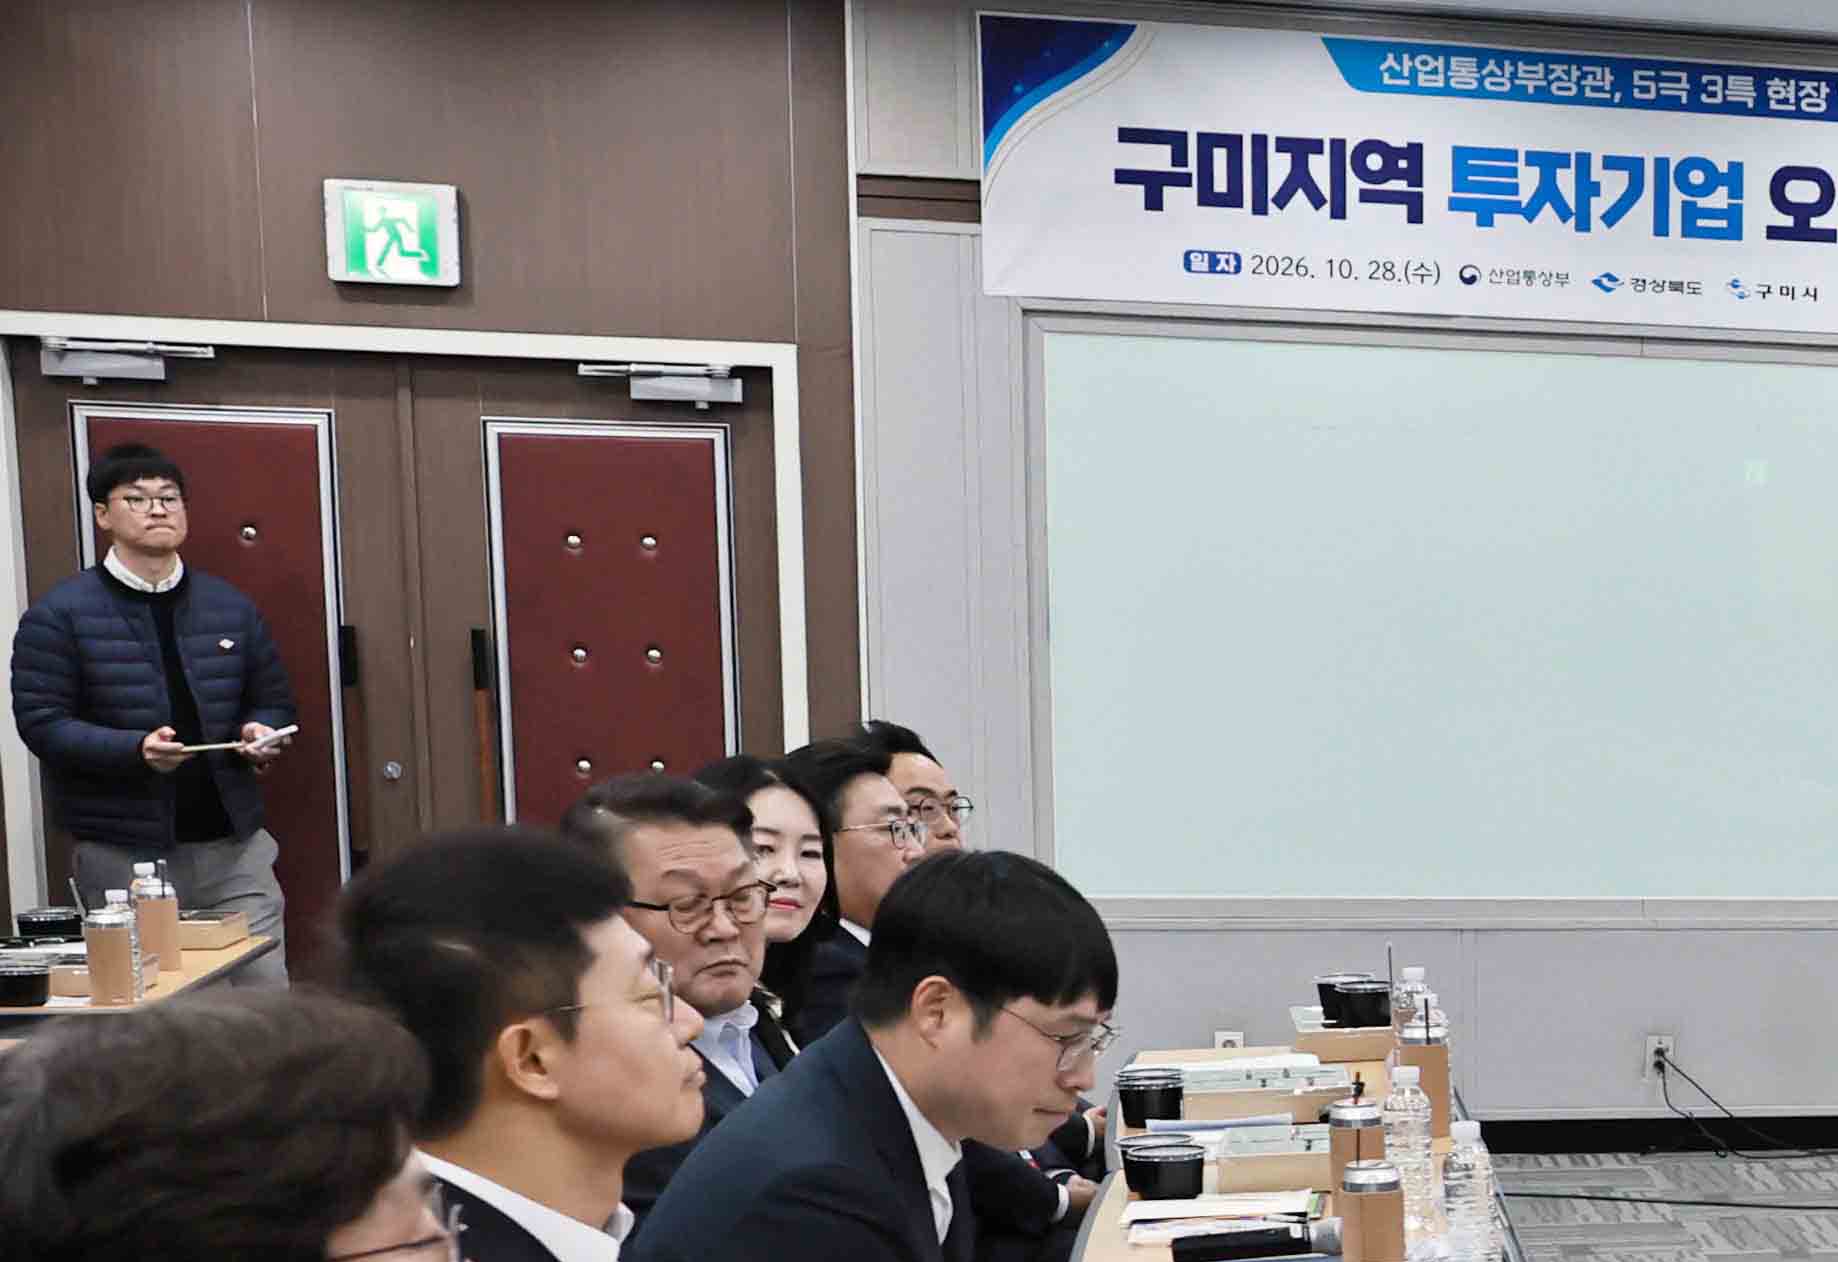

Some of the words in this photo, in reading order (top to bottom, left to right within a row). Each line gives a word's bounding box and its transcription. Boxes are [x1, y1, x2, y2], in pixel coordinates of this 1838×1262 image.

[1378, 52, 1622, 104] 산업통상부장관,
[1632, 69, 1690, 103] 5극
[1700, 73, 1757, 107] 3특
[1765, 76, 1831, 112] 현장
[1113, 126, 1425, 225] 구미지역
[1446, 144, 1745, 241] 투자기업
[1251, 254, 1316, 279] 2026.
[1326, 257, 1360, 281] 10.
[1487, 268, 1572, 289] 산업통상부
[1630, 276, 1704, 297] 경상북도
